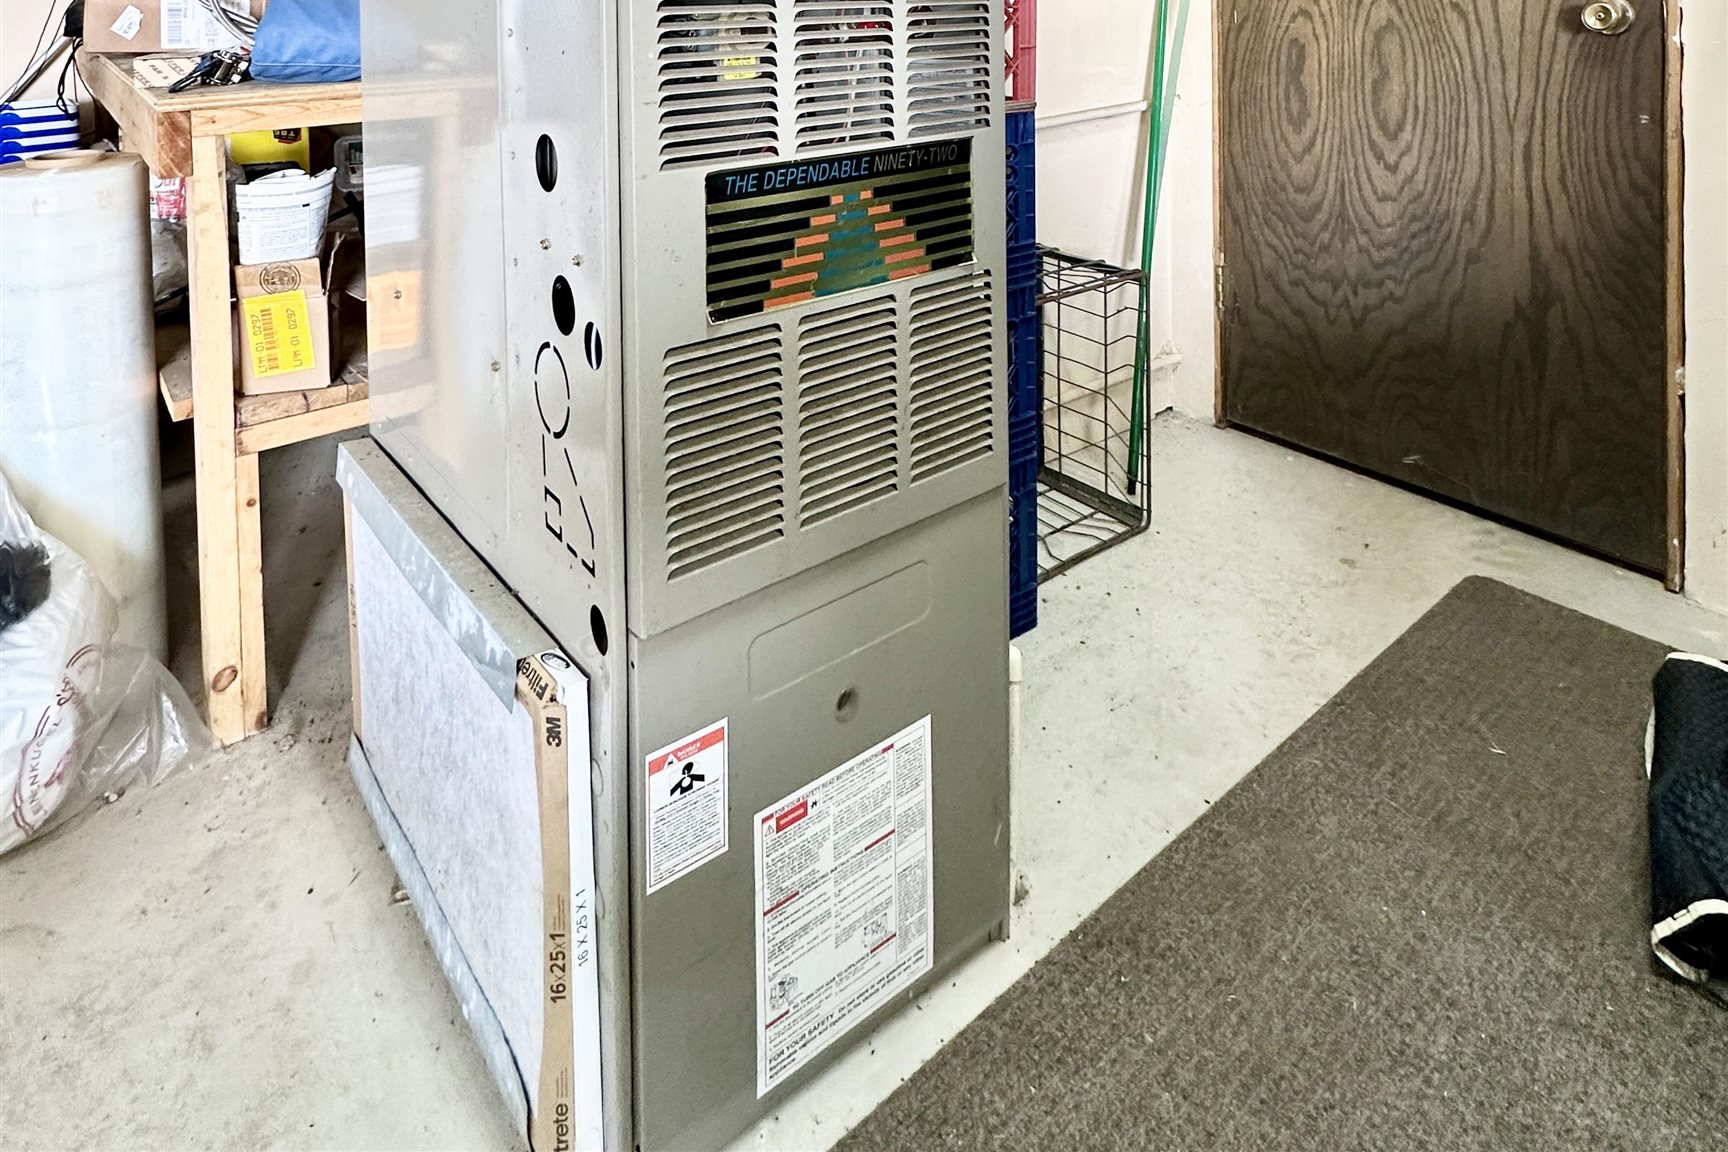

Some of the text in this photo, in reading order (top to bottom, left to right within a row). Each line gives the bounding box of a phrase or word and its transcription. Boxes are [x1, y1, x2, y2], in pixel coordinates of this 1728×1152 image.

[725, 144, 957, 195] THE DEPENDABLE NINETY-TWO
[251, 314, 262, 336] 0297
[286, 308, 298, 330] 0297
[517, 659, 549, 700] Filtre
[546, 716, 561, 747] 3M
[576, 899, 587, 911] X
[576, 915, 588, 935] 25
[576, 938, 589, 949] X
[549, 932, 566, 1003] 16x25x1
[578, 949, 589, 967] 16
[769, 1049, 784, 1064] FOR
[785, 1033, 806, 1052] YOUR
[807, 1012, 833, 1036] SAFETY
[554, 1103, 569, 1152] trete
